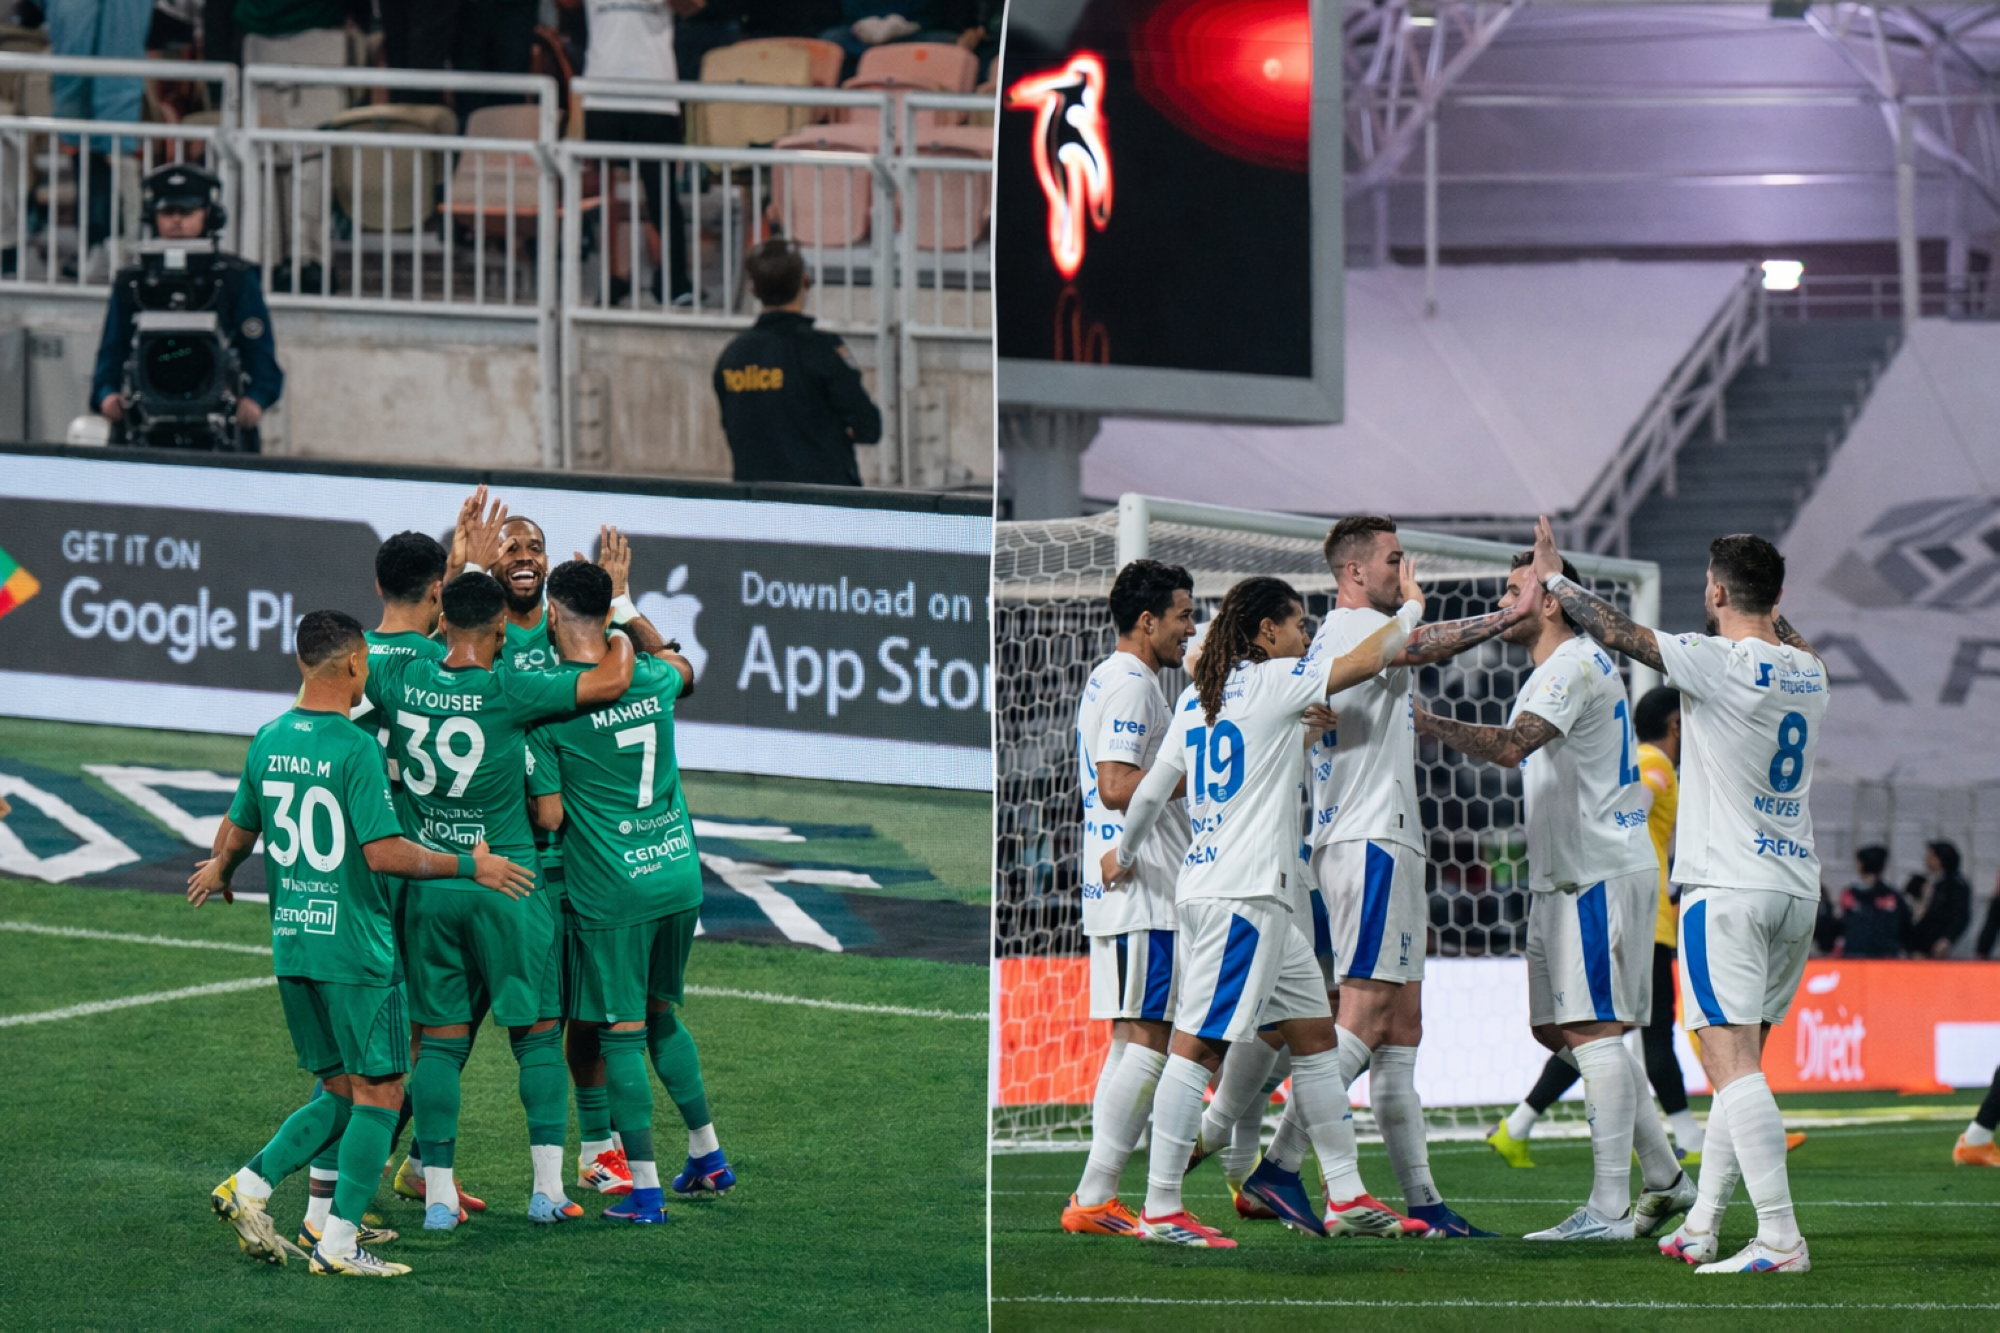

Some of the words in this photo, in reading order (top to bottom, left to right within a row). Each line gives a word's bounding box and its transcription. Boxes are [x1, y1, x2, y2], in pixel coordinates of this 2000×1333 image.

[62, 530, 118, 563] GET
[124, 534, 149, 565] IT
[154, 536, 201, 570] ON
[60, 576, 238, 664] Google
[248, 589, 304, 655] Pl
[741, 570, 917, 617] Download
[928, 592, 973, 622] on
[404, 685, 483, 711] Y.YOUSEF
[590, 695, 662, 729] MAHREZ
[736, 625, 866, 717] App
[396, 709, 486, 798] 39
[614, 722, 657, 809] 7
[1186, 719, 1246, 804] 19
[1769, 711, 1808, 793] 8
[262, 780, 346, 872] 30
[1753, 795, 1800, 818] NEVES
